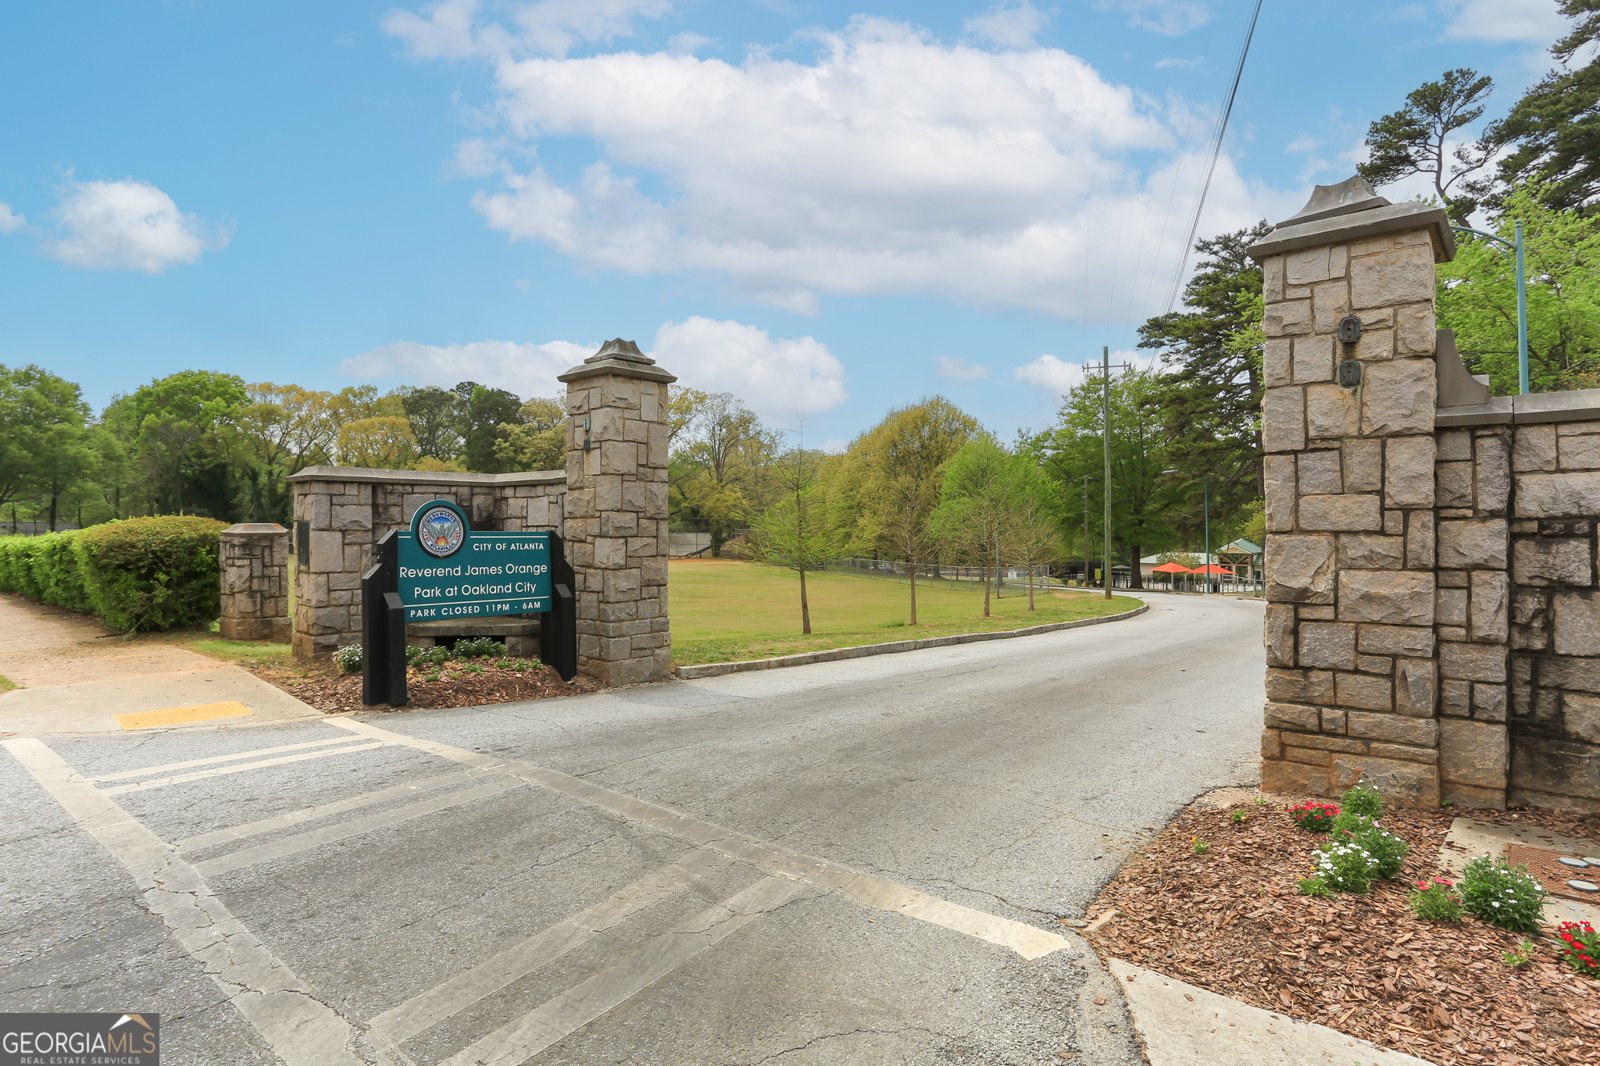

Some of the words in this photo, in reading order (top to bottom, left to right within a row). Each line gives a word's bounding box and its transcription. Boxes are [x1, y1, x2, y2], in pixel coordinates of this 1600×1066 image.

[473, 543, 492, 551] CITY
[510, 542, 544, 550] ATLANTA
[399, 566, 461, 578] Reverend
[464, 564, 503, 576] James
[505, 563, 548, 576] Orange
[414, 587, 442, 598] Park
[445, 586, 458, 596] at
[461, 583, 512, 596] Oakland
[515, 582, 537, 594] City
[410, 609, 436, 618] PARK
[441, 606, 480, 616] CLOSED
[485, 604, 510, 613] 11PM
[522, 601, 541, 610] 6AM
